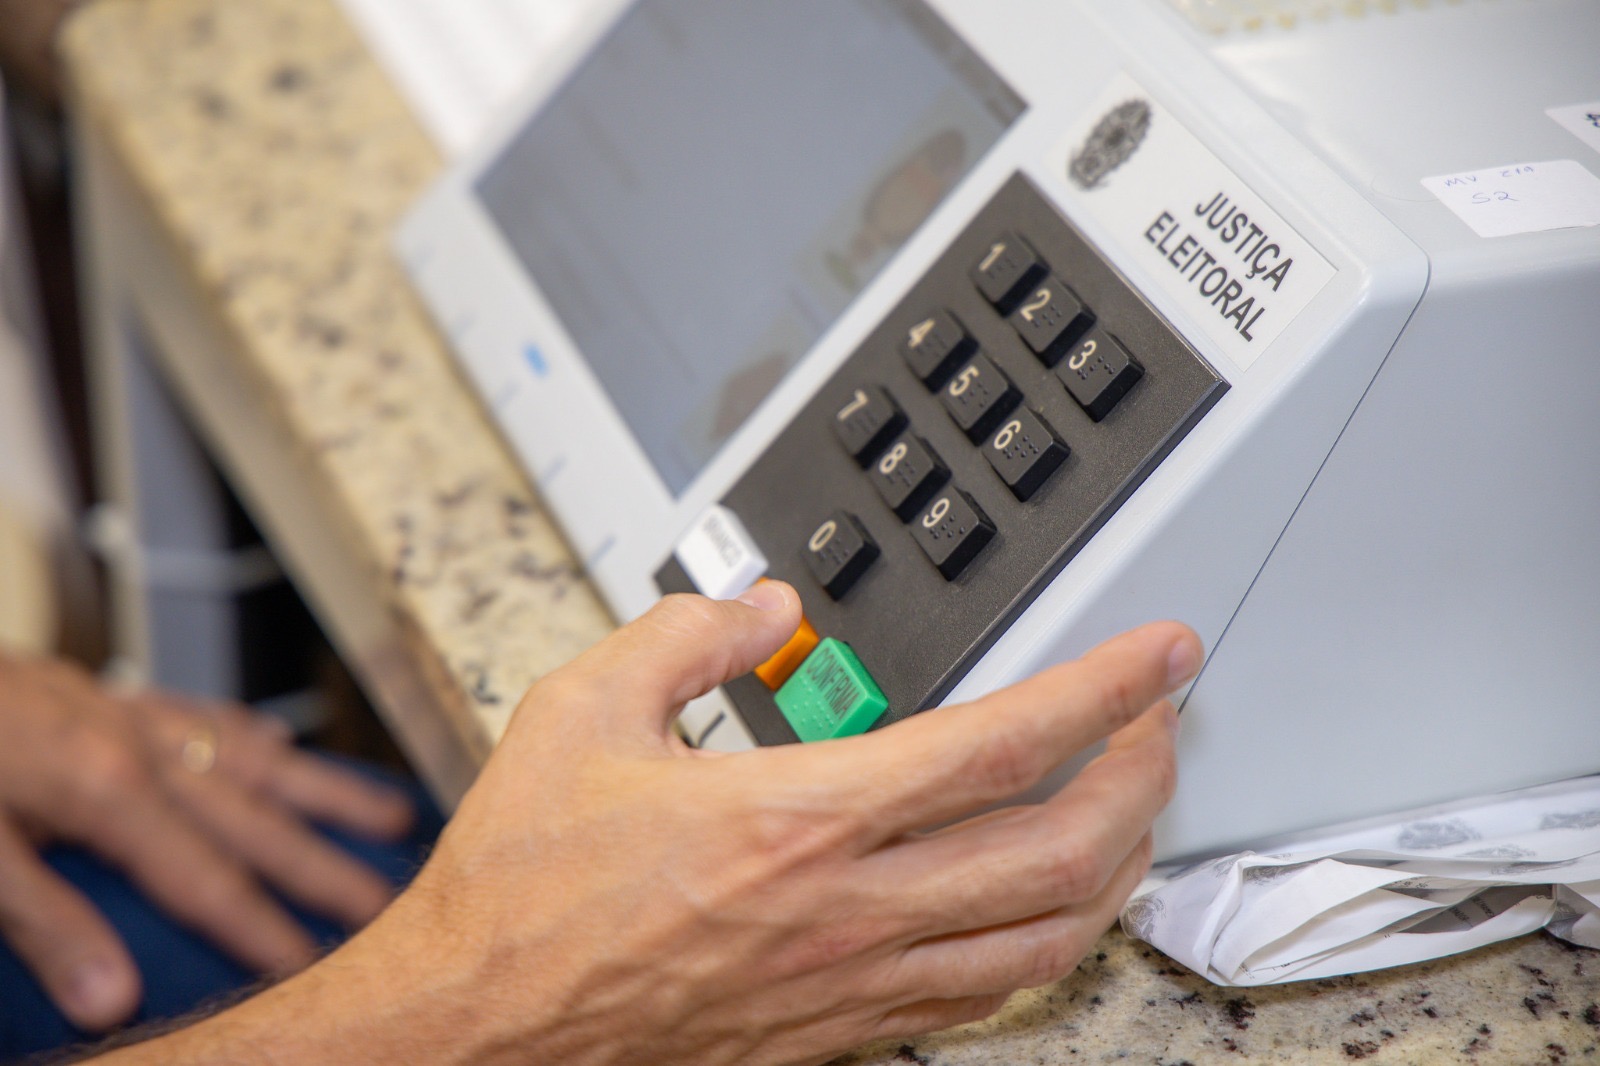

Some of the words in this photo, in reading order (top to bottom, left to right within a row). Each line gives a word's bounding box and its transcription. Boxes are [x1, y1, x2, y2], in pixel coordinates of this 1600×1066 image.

[978, 242, 1007, 272] 1
[1193, 192, 1294, 293] JUSTIÇA
[1143, 210, 1267, 343] ELEITORAL
[1020, 288, 1052, 322] 2
[908, 318, 936, 348] 4
[1068, 339, 1098, 371] 3
[949, 364, 980, 397] 5
[836, 388, 869, 422] 7
[993, 419, 1022, 450] 6
[879, 442, 908, 474] 8
[922, 497, 951, 529] 9
[808, 519, 837, 552] 0
[805, 646, 861, 721] CONFIRMA
